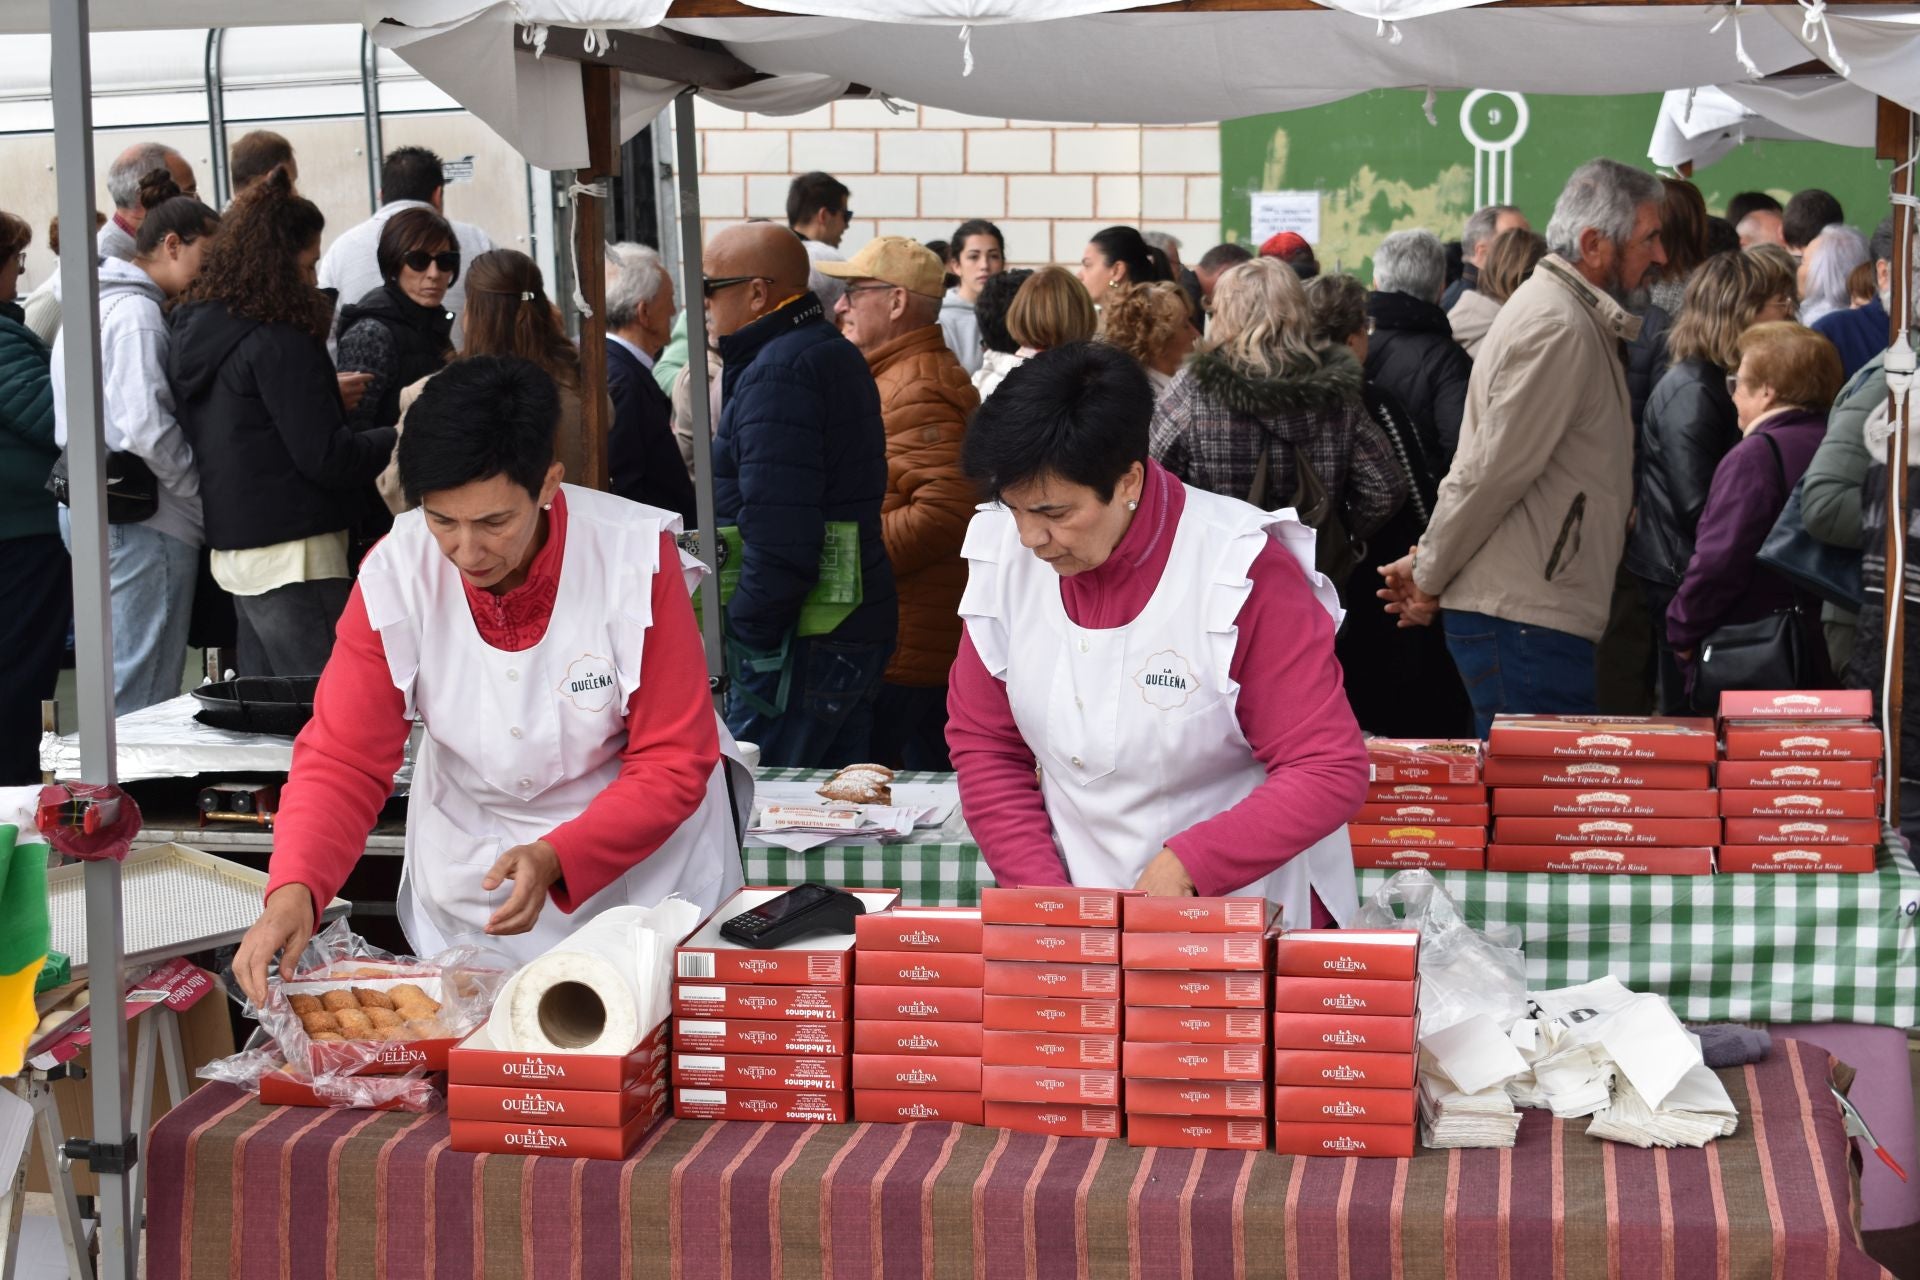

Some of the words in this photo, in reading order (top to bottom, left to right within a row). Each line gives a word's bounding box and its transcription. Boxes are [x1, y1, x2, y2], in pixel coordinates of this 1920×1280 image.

[1488, 108, 1501, 126] 9
[571, 675, 613, 692] QUELEÑA
[1146, 674, 1186, 690] QUELEÑA
[1554, 747, 1586, 755] Producto
[1588, 747, 1610, 757] Típico
[1635, 750, 1655, 758] Rioja
[1543, 775, 1575, 783] Producto
[1577, 775, 1599, 784] Típico
[1624, 777, 1643, 785] Rioja
[1781, 779, 1801, 787] Típico
[1553, 805, 1585, 813] Producto
[1588, 805, 1610, 814] Típico
[1556, 834, 1587, 842] Producto
[1590, 834, 1612, 843] Típico
[1637, 835, 1656, 843] Rioja
[1547, 862, 1579, 870] Producto
[1581, 862, 1603, 872] Típico
[1606, 863, 1614, 871] de
[1616, 863, 1626, 871] La
[1628, 864, 1647, 872] Rioja
[188, 972, 207, 988] Alto
[168, 984, 194, 1004] Oleico
[785, 1009, 823, 1018] Medianos
[826, 1010, 836, 1018] 12
[785, 1044, 823, 1052] Medianos
[826, 1045, 836, 1053] 12
[785, 1079, 823, 1087] Medianos
[825, 1080, 835, 1088] 12
[787, 1112, 824, 1120] Medianos
[826, 1113, 836, 1121] 12
